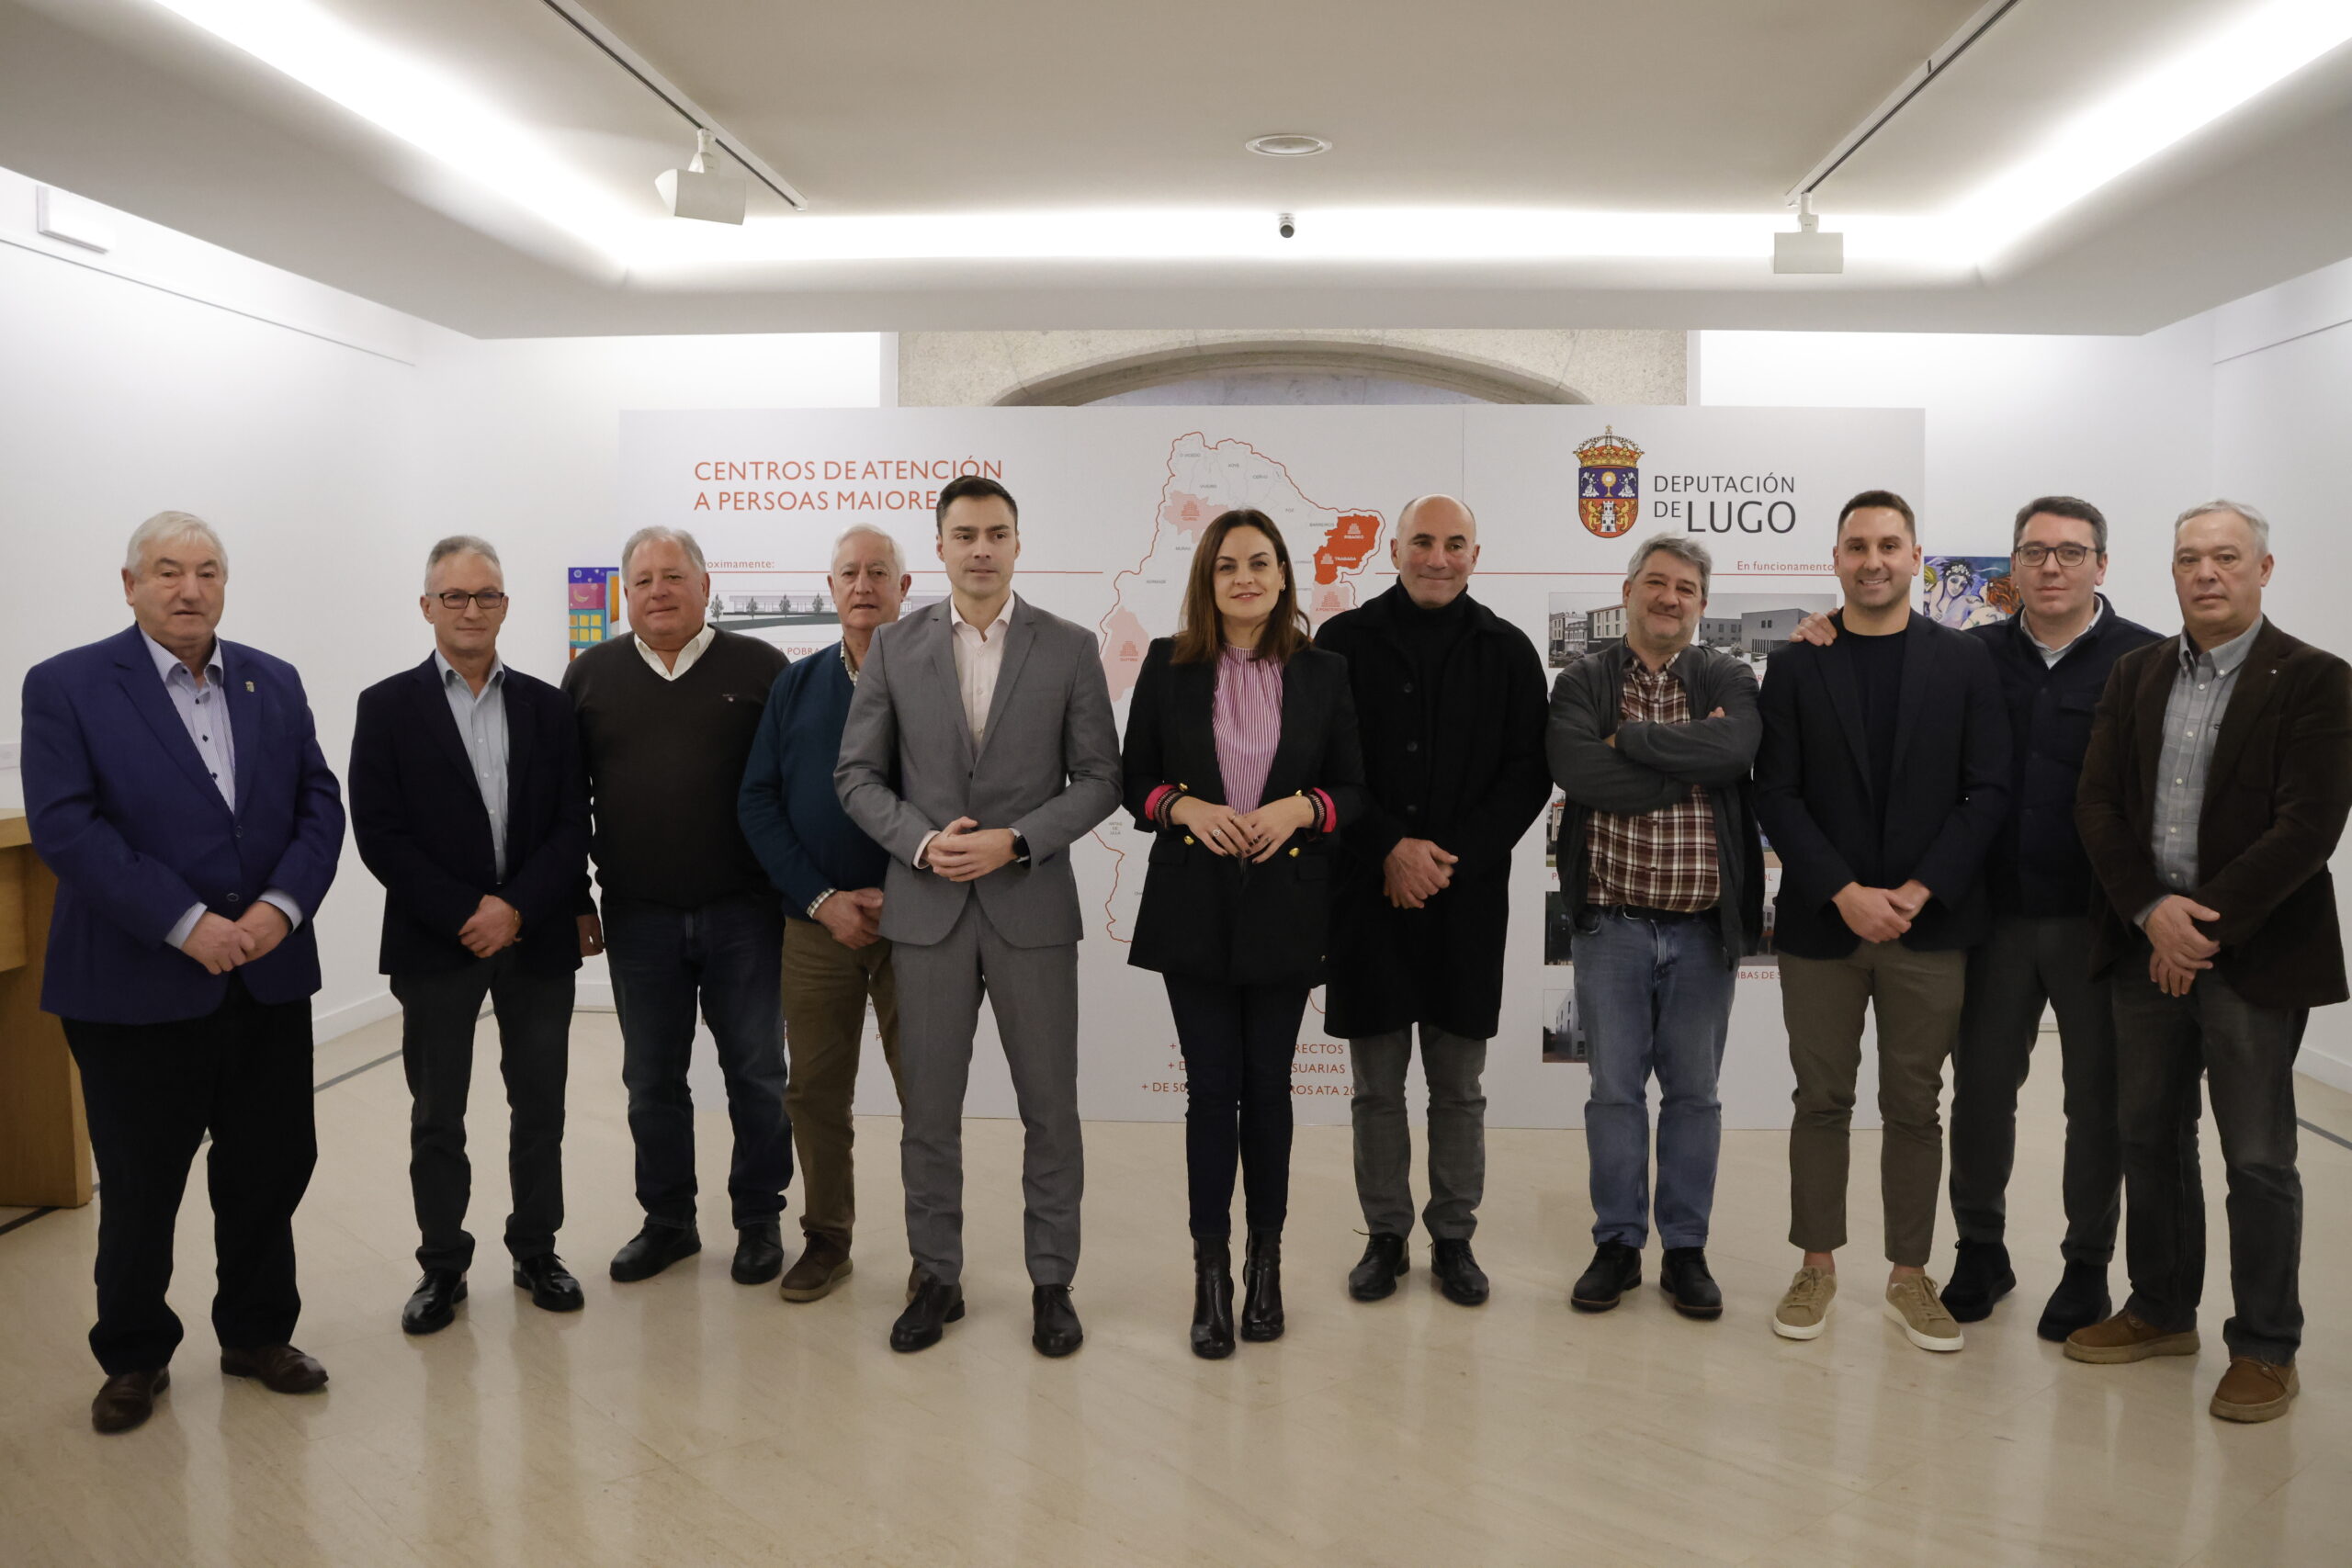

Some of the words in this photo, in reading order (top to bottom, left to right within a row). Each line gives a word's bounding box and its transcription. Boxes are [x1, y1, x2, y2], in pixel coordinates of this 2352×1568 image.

[695, 461, 816, 480] CENTROS
[824, 460, 857, 480] DE
[861, 456, 1002, 480] ATENCIÓN
[1654, 471, 1795, 493] DEPUTACIÓN
[694, 491, 711, 511] A
[718, 491, 829, 511] PERSOAS
[837, 491, 938, 511] MAIORE
[1654, 501, 1682, 518] DE
[1687, 500, 1796, 534] LUGO
[705, 558, 775, 569] oximamente:
[1737, 560, 1750, 570] En
[1295, 1043, 1344, 1055] RECTOS
[1291, 1063, 1346, 1074] SUARIAS
[1152, 1082, 1170, 1092] DE
